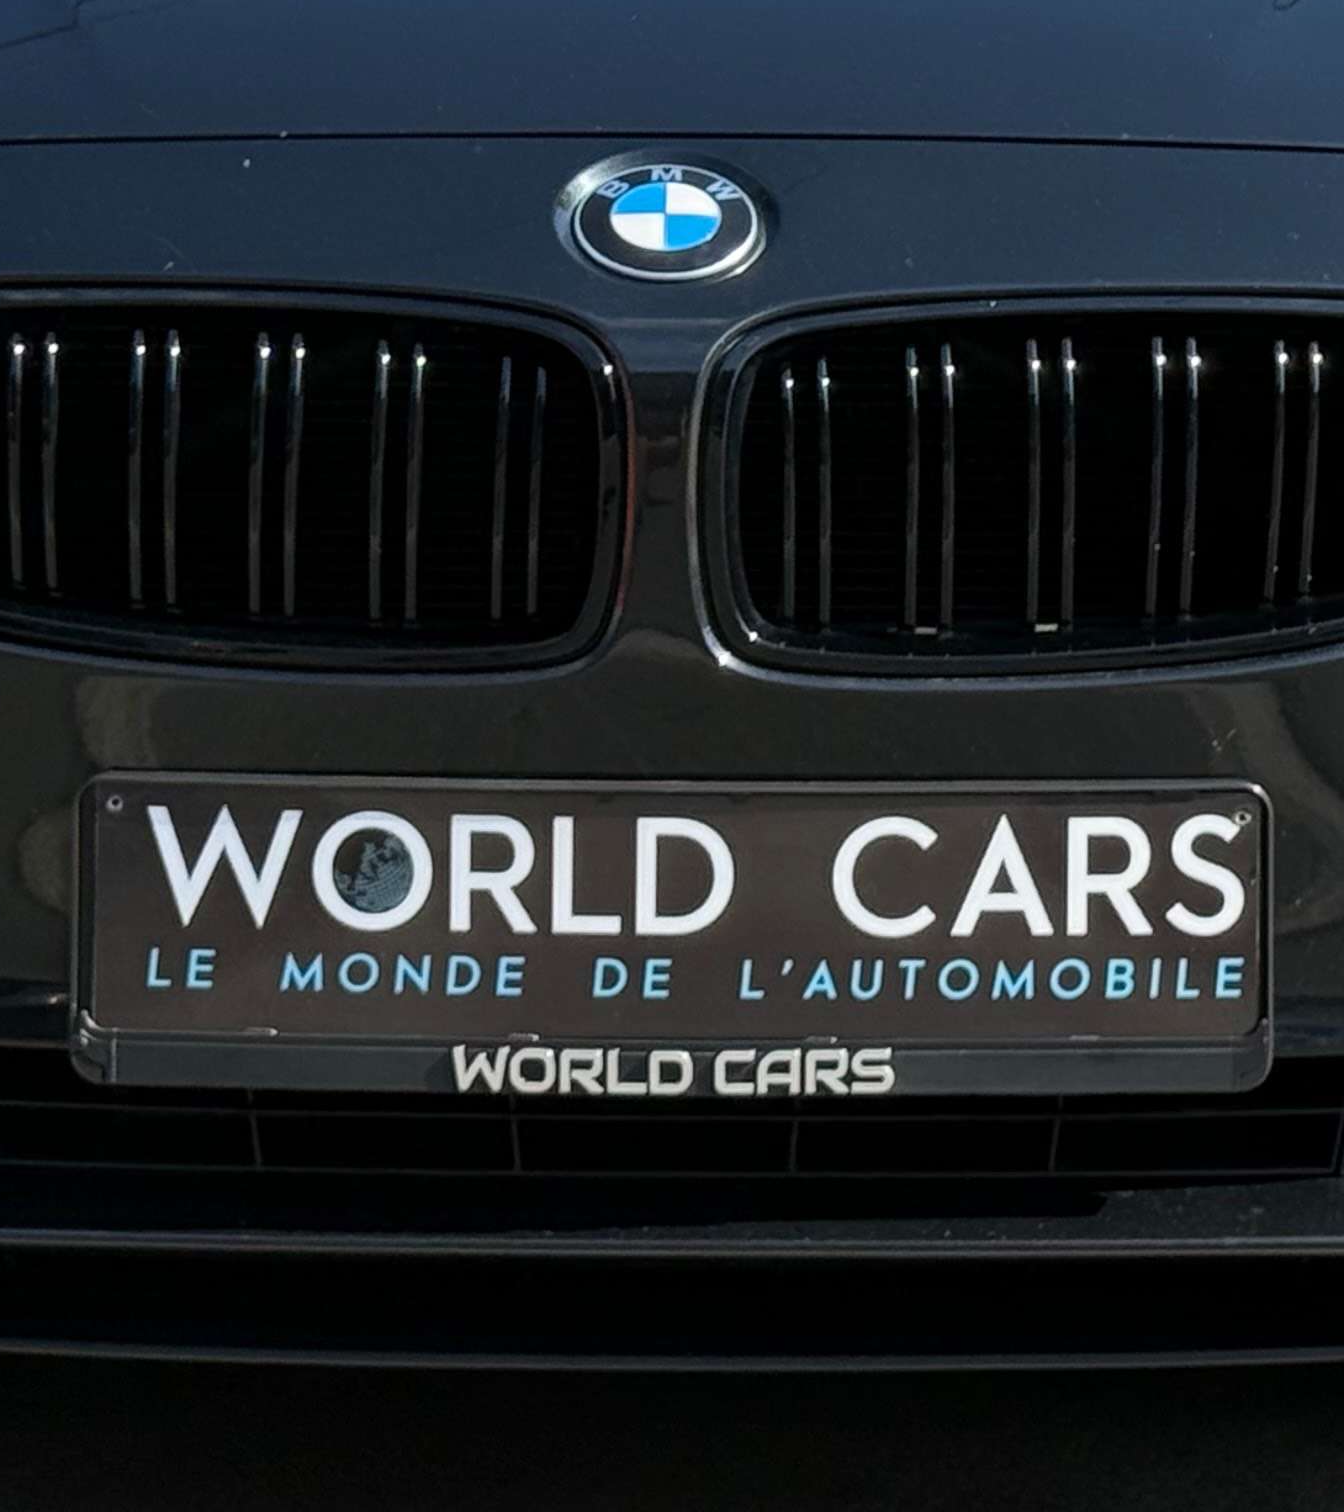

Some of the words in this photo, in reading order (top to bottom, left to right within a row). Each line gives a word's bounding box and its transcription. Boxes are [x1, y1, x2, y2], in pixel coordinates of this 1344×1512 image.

[594, 167, 744, 201] BMW
[147, 804, 736, 937] WORLD
[831, 813, 1246, 939] CARS
[146, 948, 216, 989] LE
[279, 952, 526, 997] MONDE
[592, 957, 673, 1000] DE
[739, 956, 1245, 1002] L'AUTOMOBILE
[452, 1044, 694, 1096] WORLD
[714, 1046, 896, 1097] CARS
